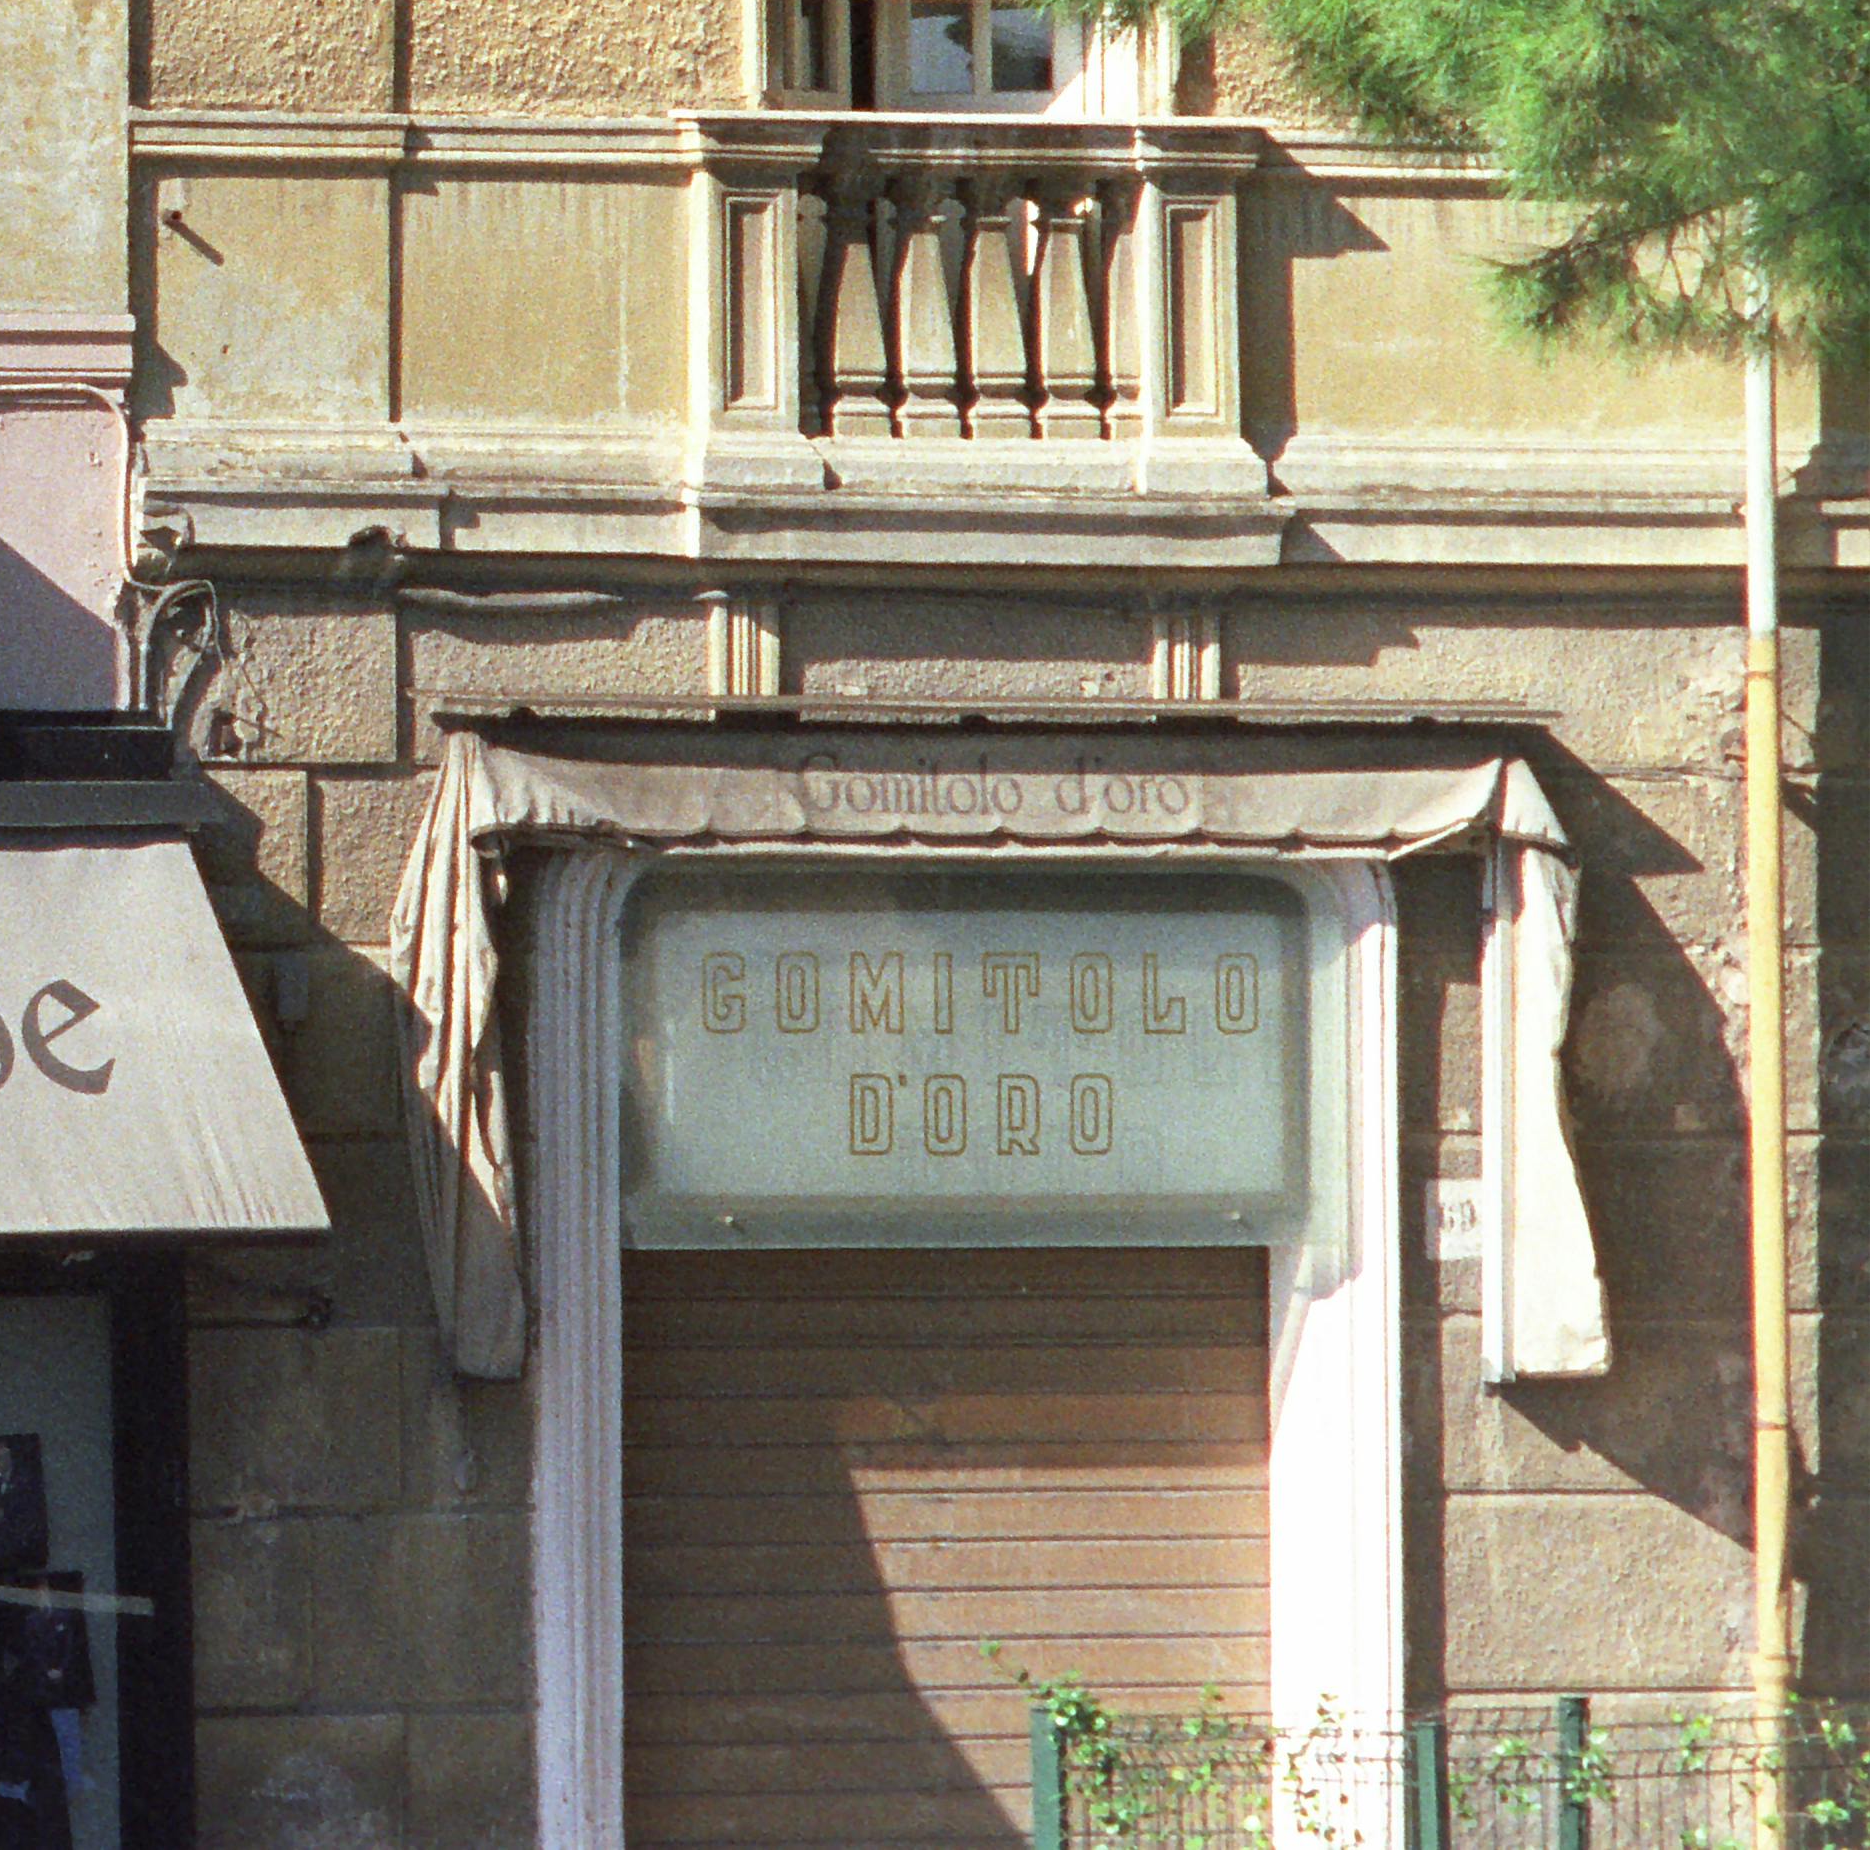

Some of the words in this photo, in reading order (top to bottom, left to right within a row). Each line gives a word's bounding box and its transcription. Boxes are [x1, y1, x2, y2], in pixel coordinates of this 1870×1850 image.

[796, 751, 1023, 816] Gomitolo
[1053, 754, 1192, 816] d'oro
[701, 951, 1260, 1036] GOMITOLO
[848, 1072, 1114, 1157] D'ORO
